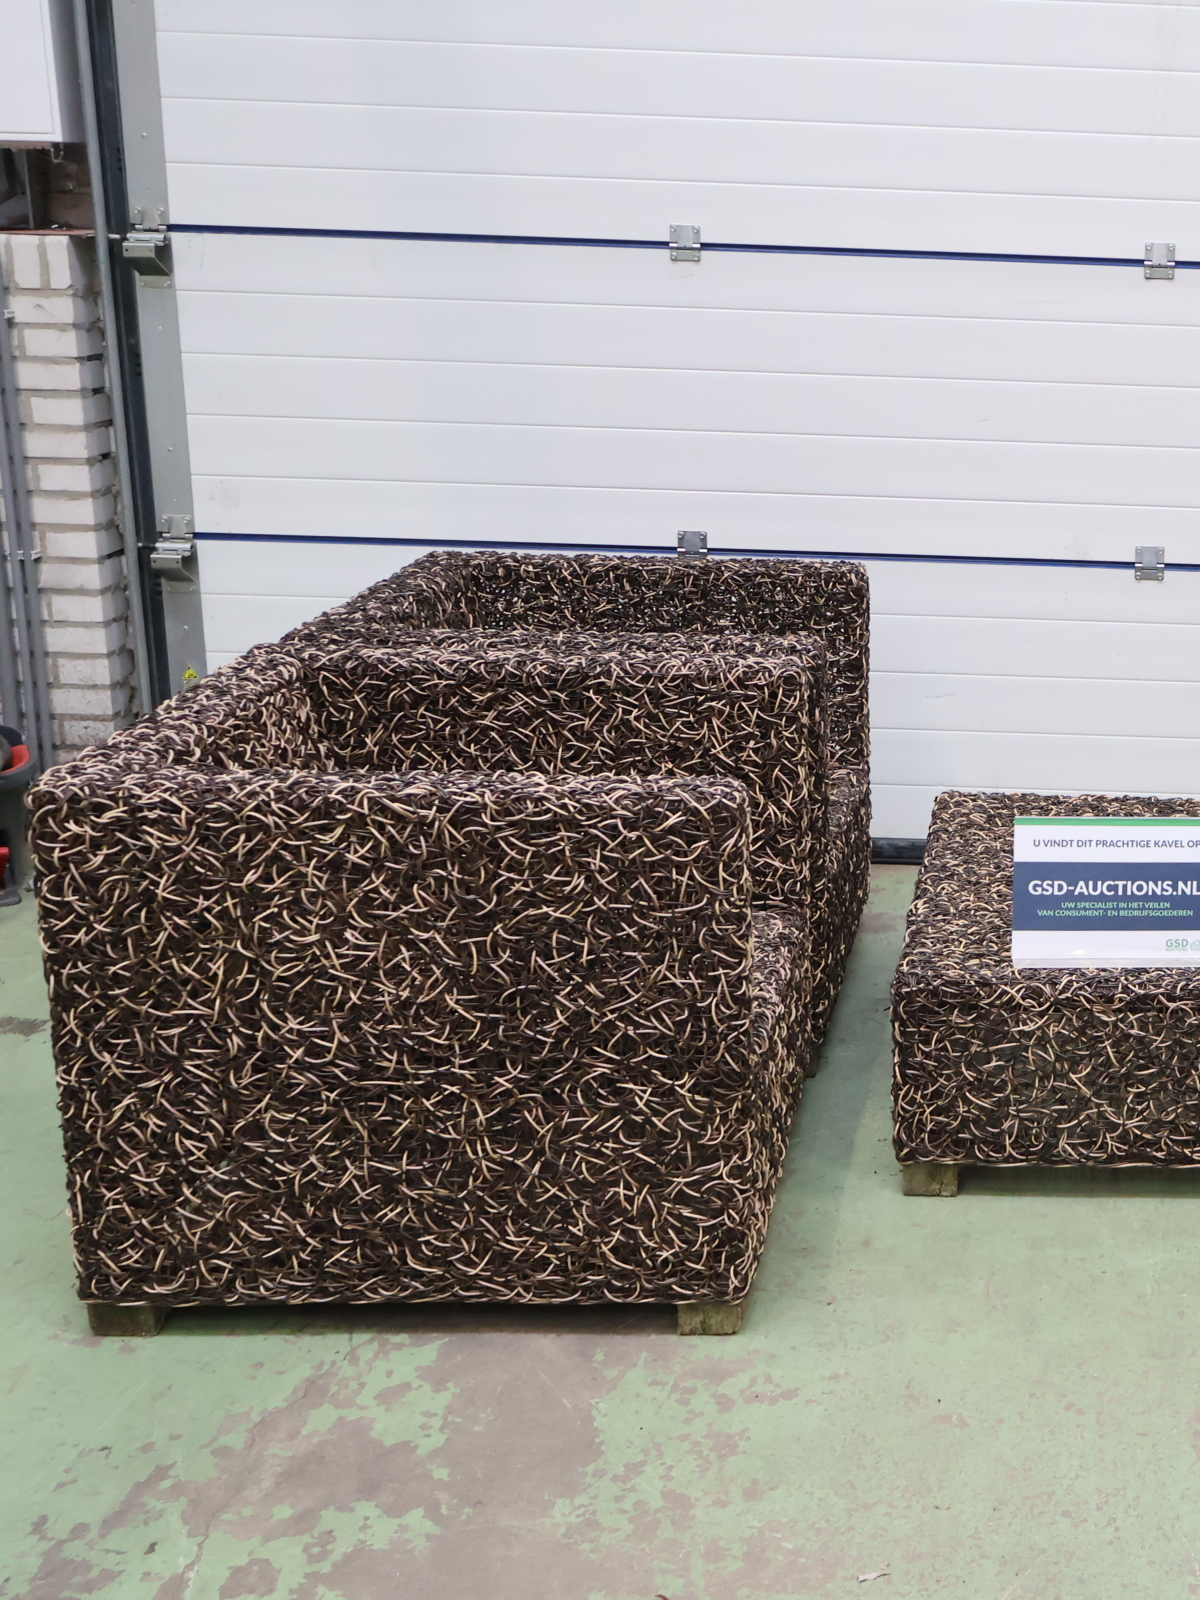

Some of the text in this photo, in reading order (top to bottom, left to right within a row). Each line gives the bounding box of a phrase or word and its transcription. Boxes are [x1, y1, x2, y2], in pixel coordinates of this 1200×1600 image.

[1033, 839, 1041, 847] U
[1042, 839, 1074, 848] VINDT
[1076, 839, 1093, 848] DIT
[1095, 839, 1152, 848] PRACHTIGE
[1153, 839, 1185, 848] KAVEL
[1165, 938, 1189, 948] GSD
